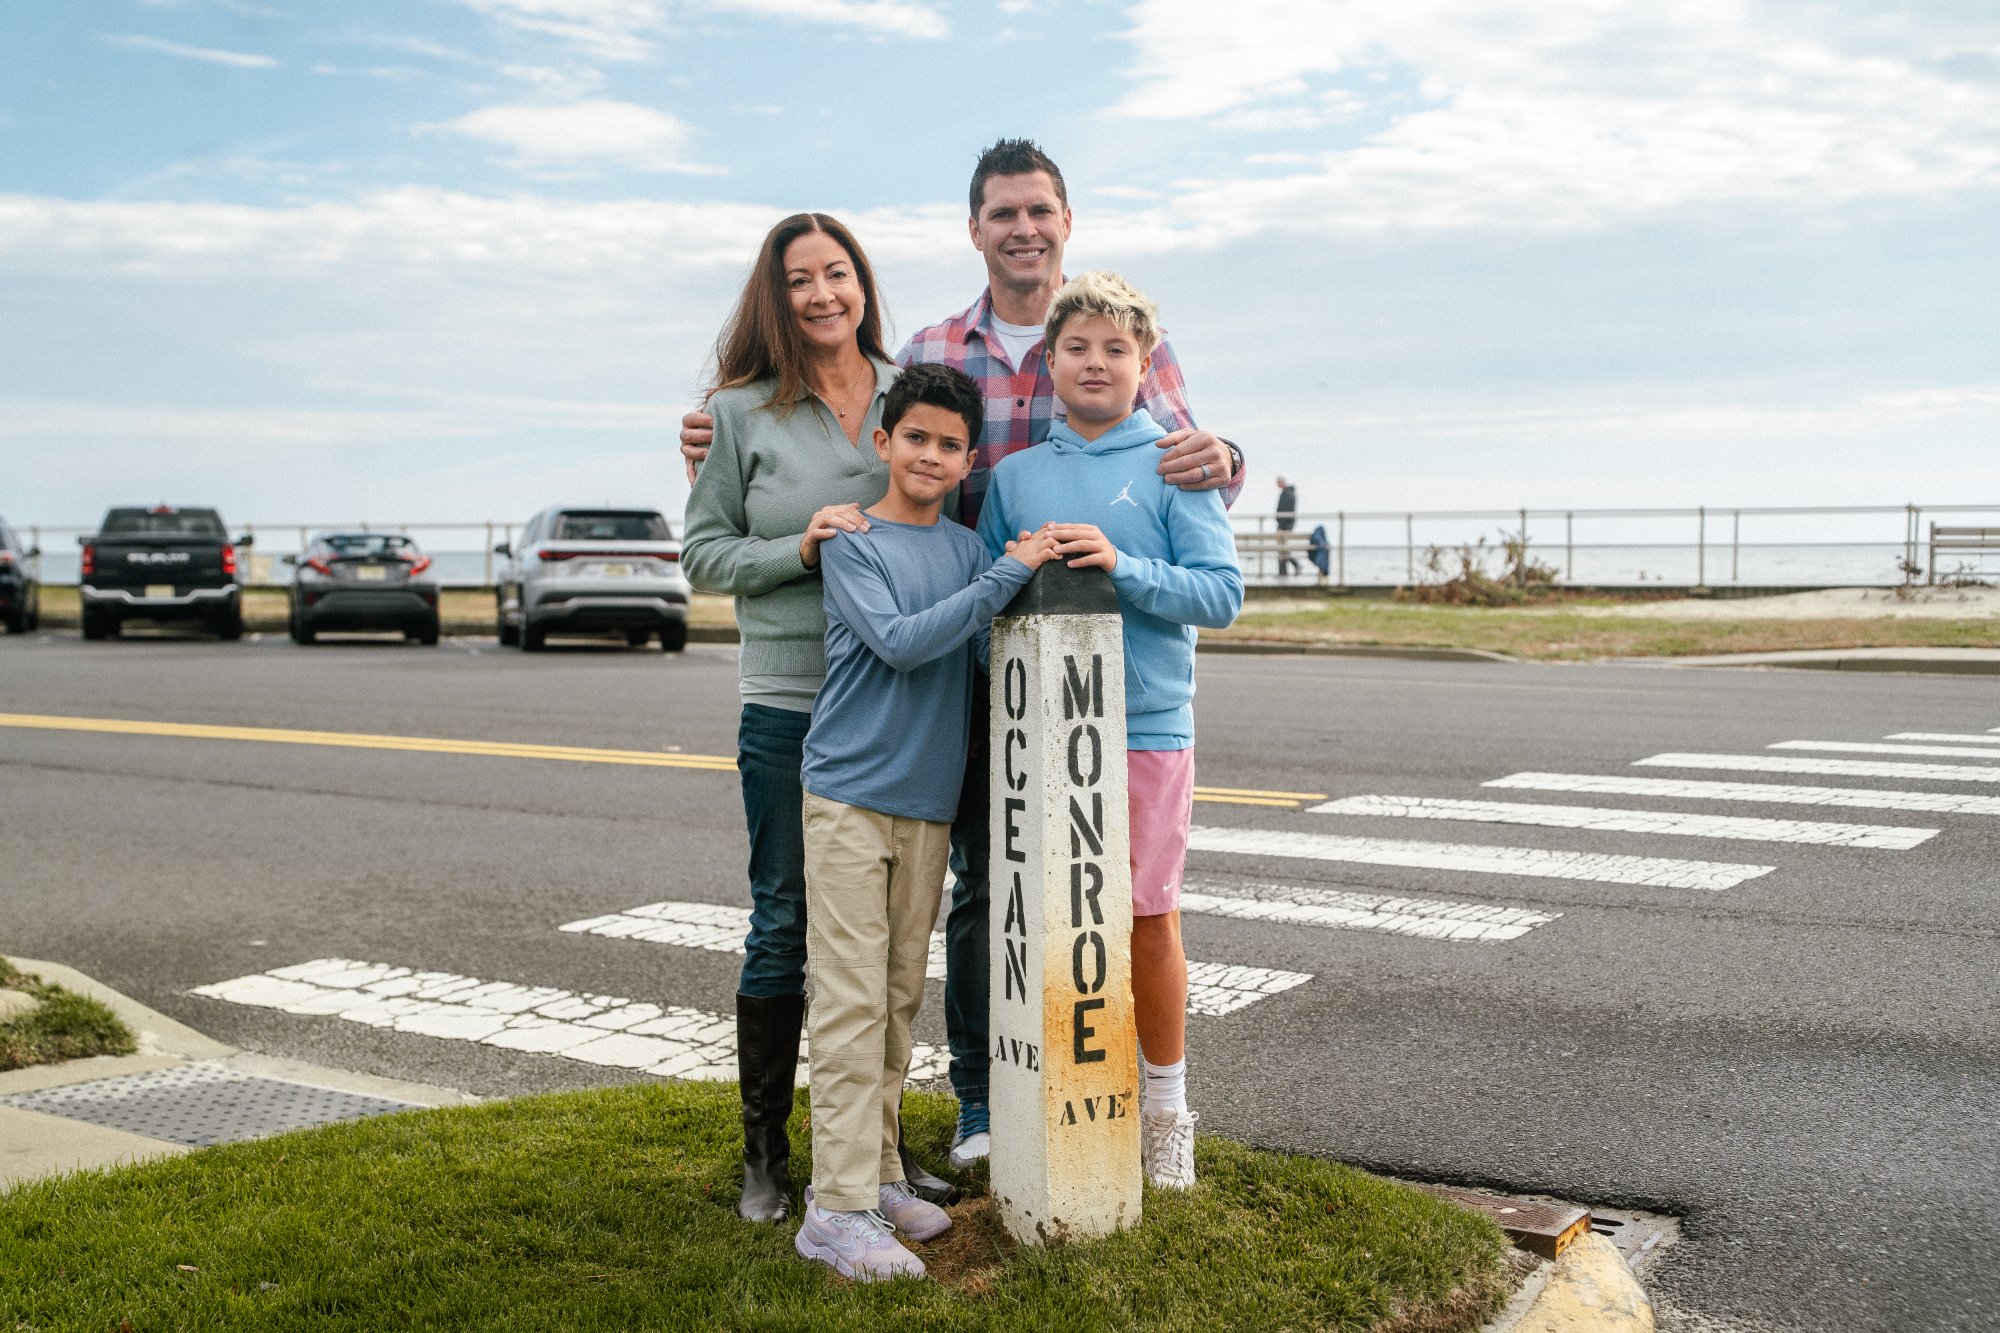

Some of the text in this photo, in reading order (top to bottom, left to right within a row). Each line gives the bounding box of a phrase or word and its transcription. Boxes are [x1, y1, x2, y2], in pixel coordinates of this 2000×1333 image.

[995, 657, 1039, 1072] OCEAN AVE
[1059, 654, 1129, 1126] MONROE AVE
